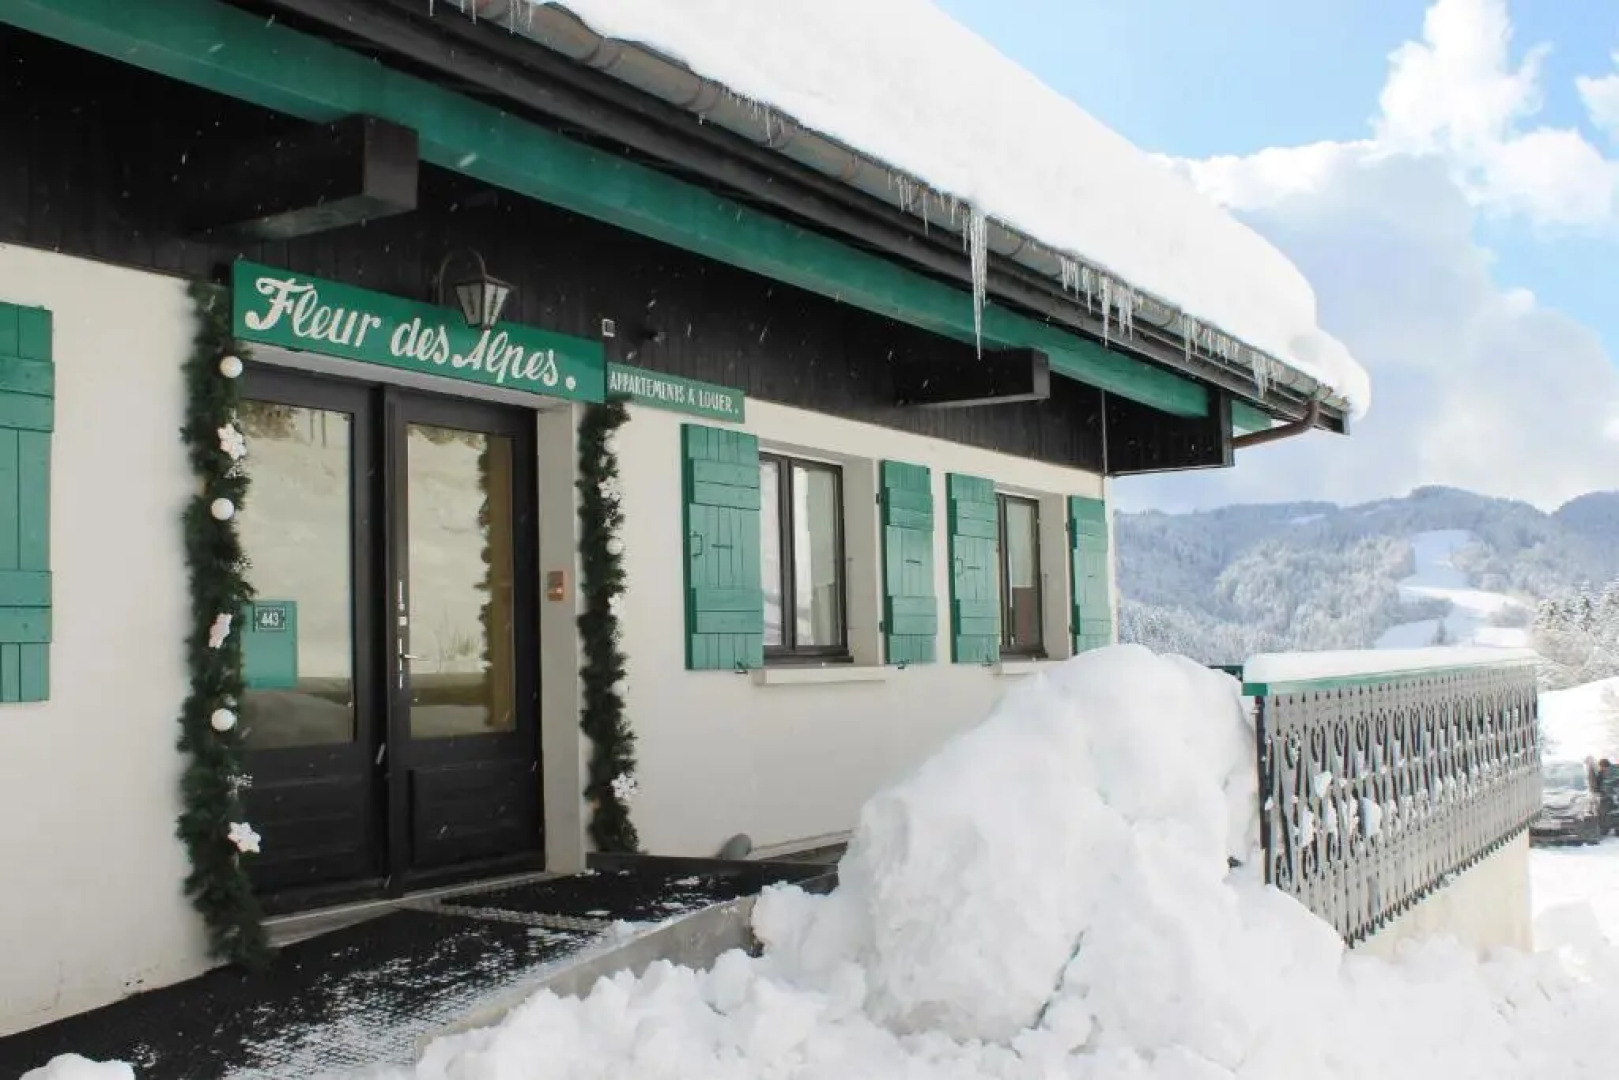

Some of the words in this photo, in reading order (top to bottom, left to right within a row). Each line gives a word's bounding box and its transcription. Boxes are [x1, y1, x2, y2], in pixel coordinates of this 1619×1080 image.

[244, 277, 382, 348] Fleur
[390, 317, 450, 364] des
[609, 371, 685, 404] APPARTEMENTS
[260, 611, 279, 627] 443
